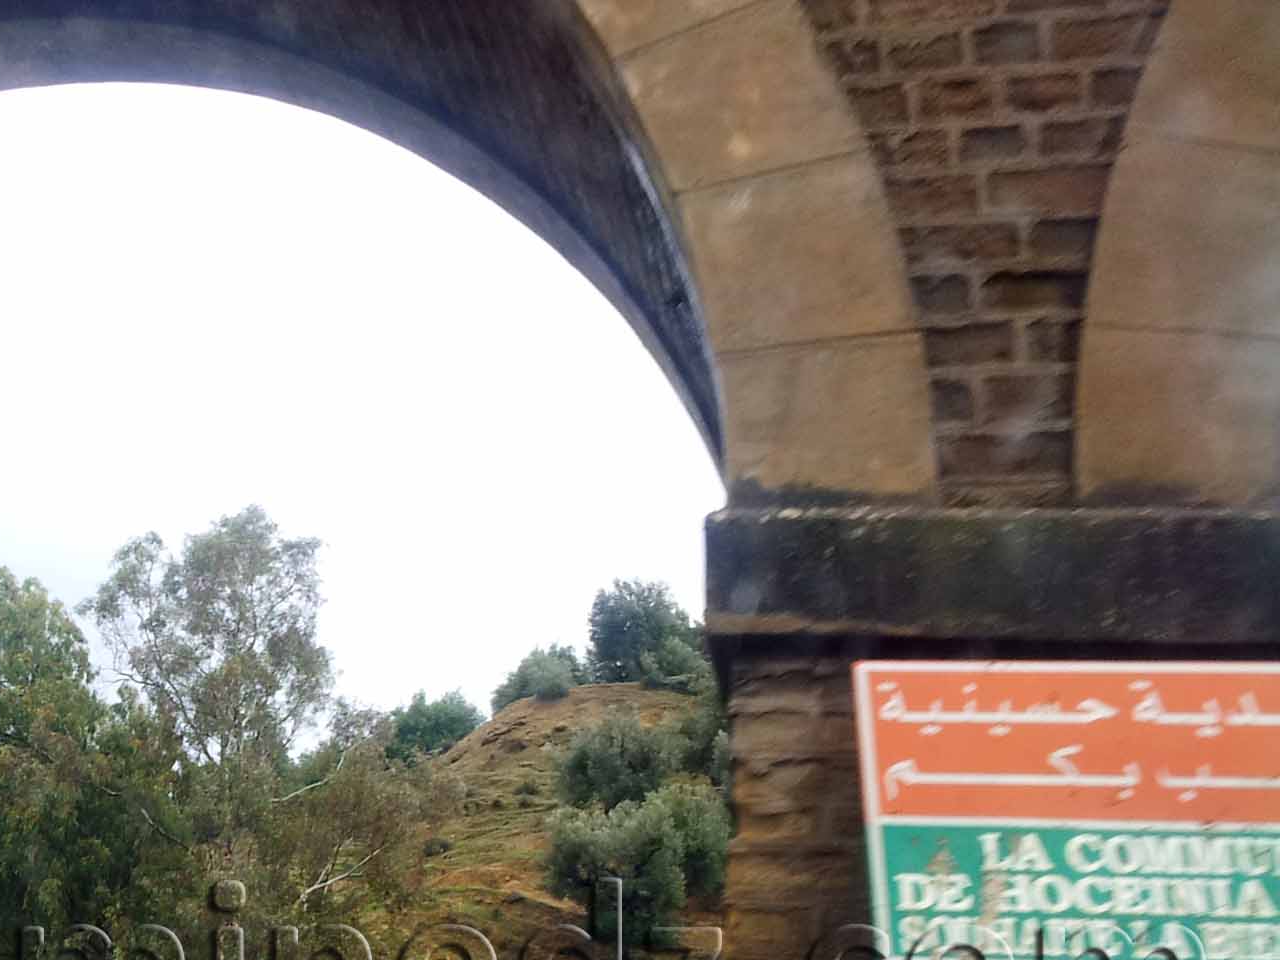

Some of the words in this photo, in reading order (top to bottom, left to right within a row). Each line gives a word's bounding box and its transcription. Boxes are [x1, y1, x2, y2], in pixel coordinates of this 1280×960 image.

[876, 682, 1119, 736] حسينية
[977, 832, 1055, 872] LA
[893, 873, 976, 911] DE
[1128, 919, 1195, 960] LA
